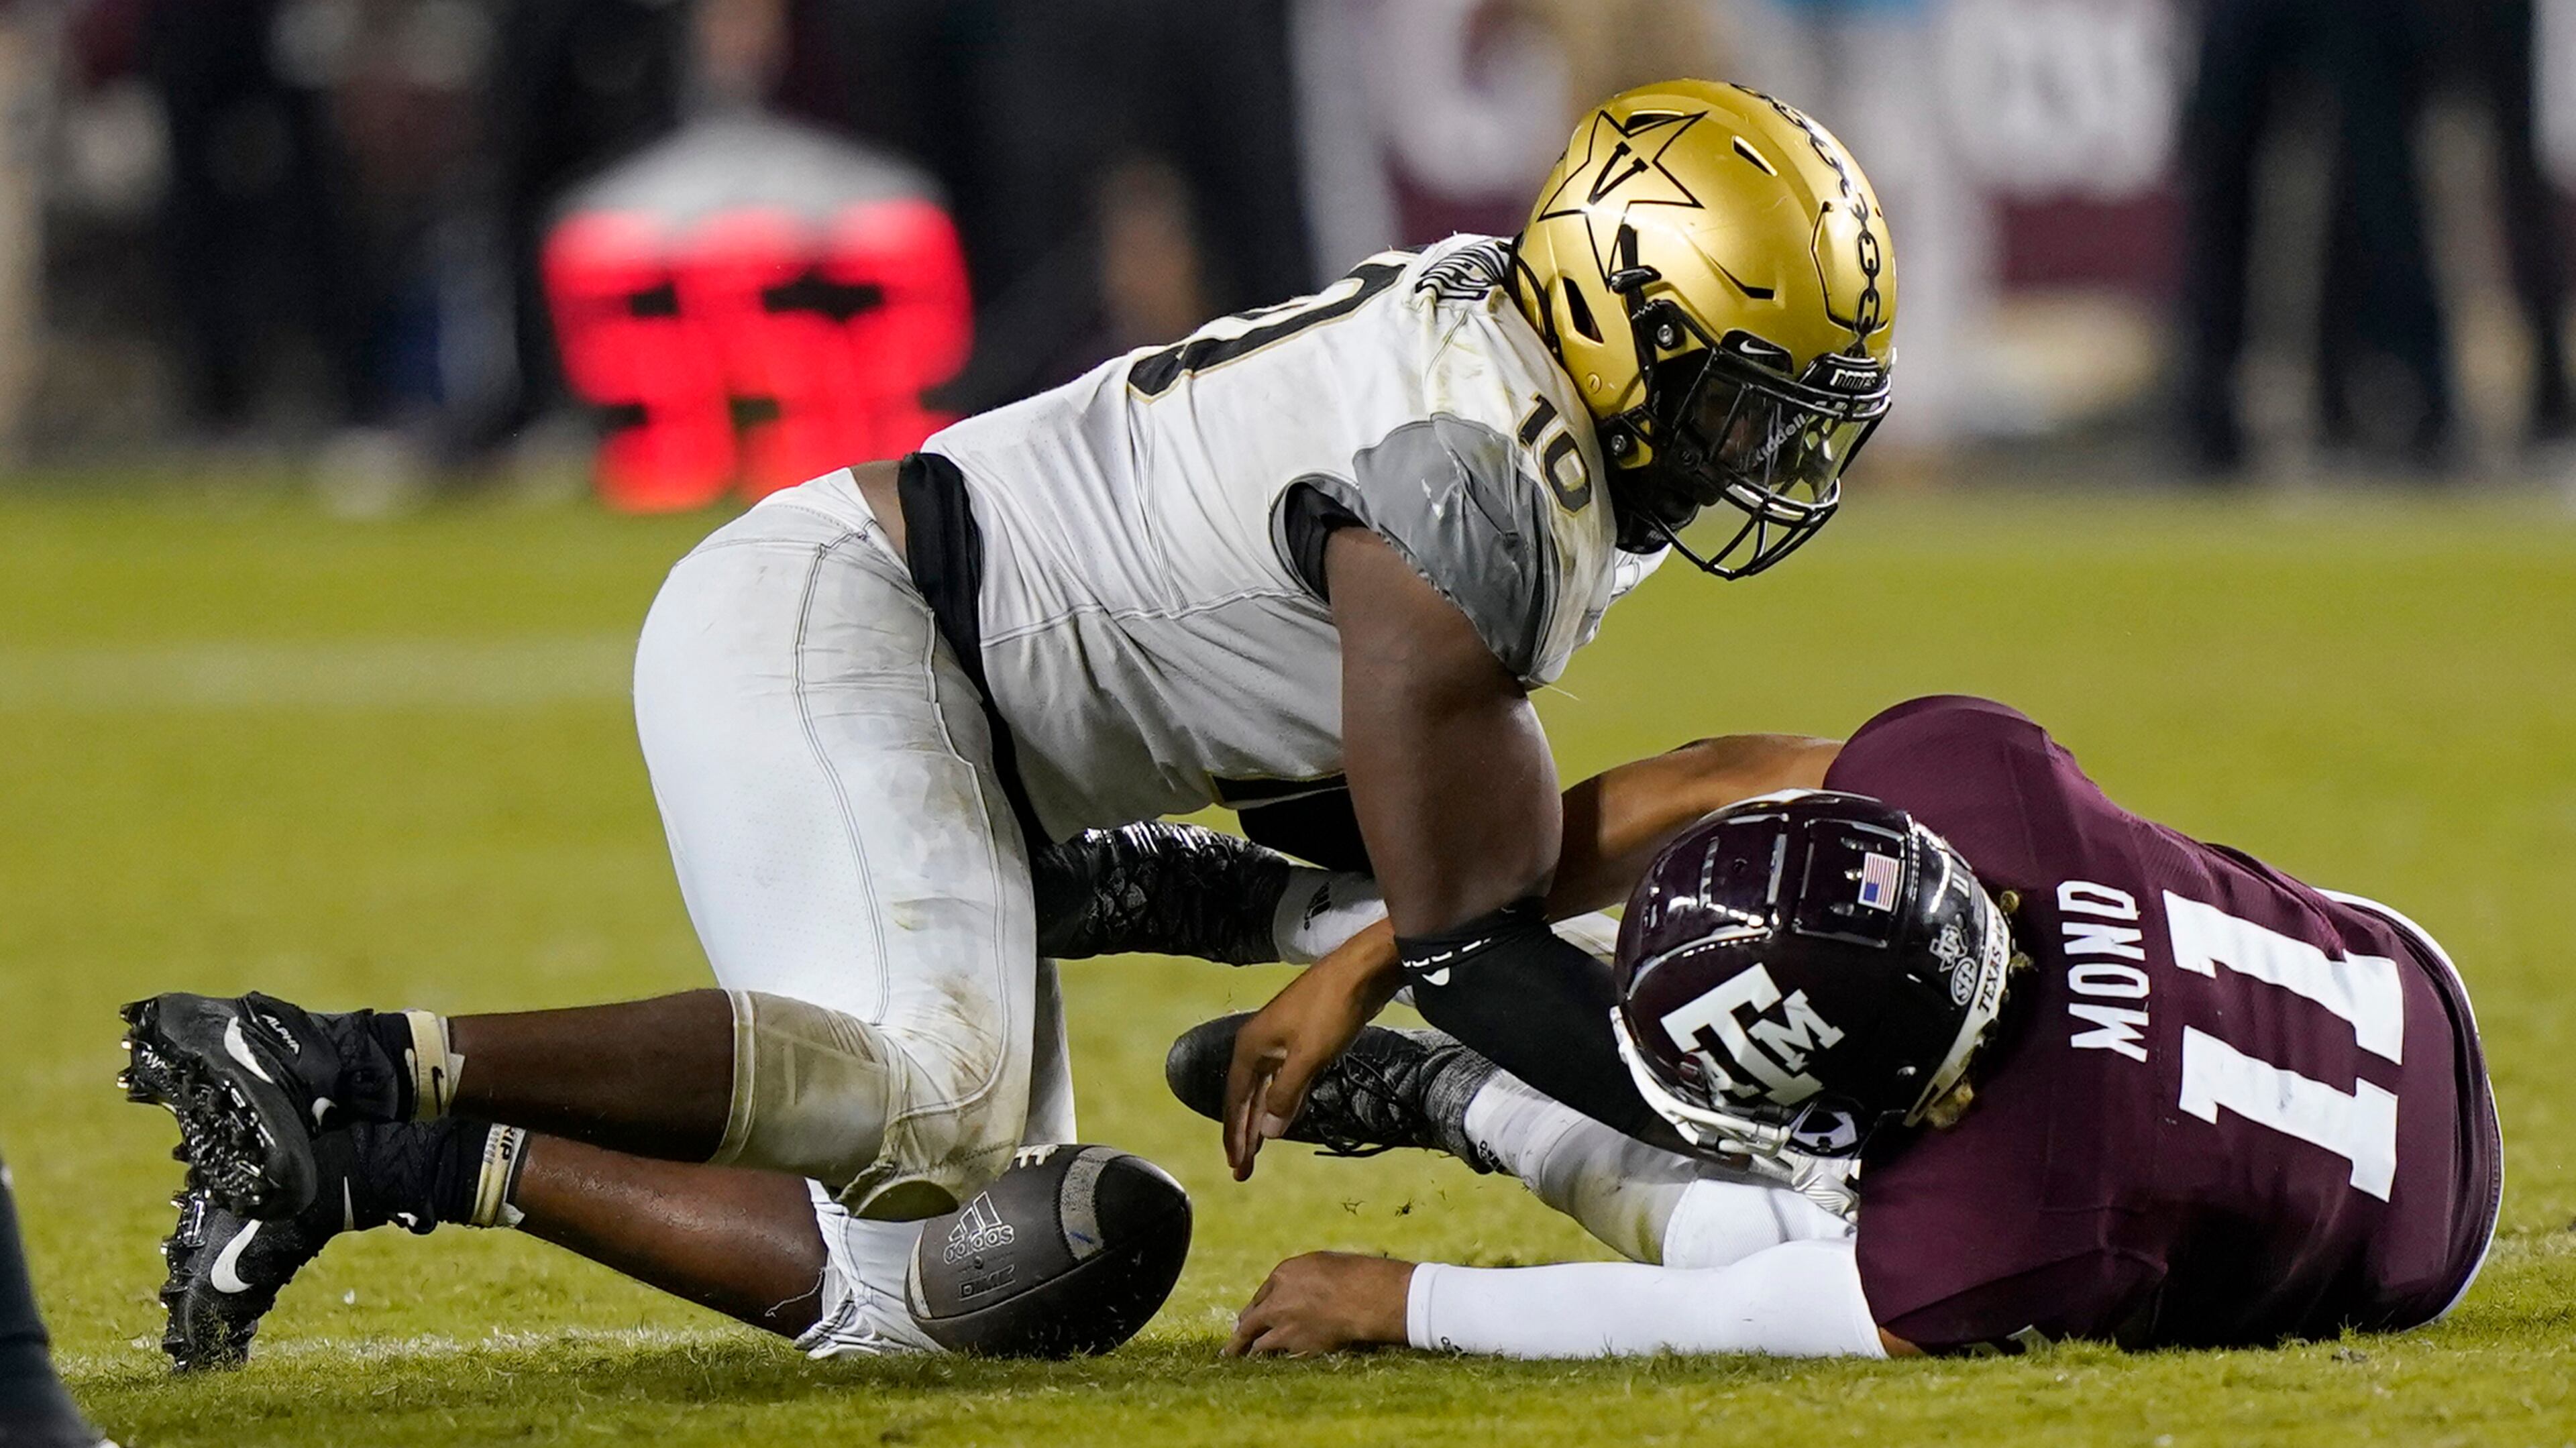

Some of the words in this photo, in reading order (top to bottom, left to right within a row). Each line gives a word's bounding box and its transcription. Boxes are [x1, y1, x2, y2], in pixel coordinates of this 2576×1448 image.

[1516, 392, 1593, 518] 10
[1752, 412, 1807, 468] iddell
[1978, 946, 2002, 1013] TEXAS
[2057, 880, 2150, 1063] MOND
[261, 1014, 300, 1054] ALPHA
[2163, 889, 2404, 1203] 11
[944, 1225, 1014, 1265] adidas
